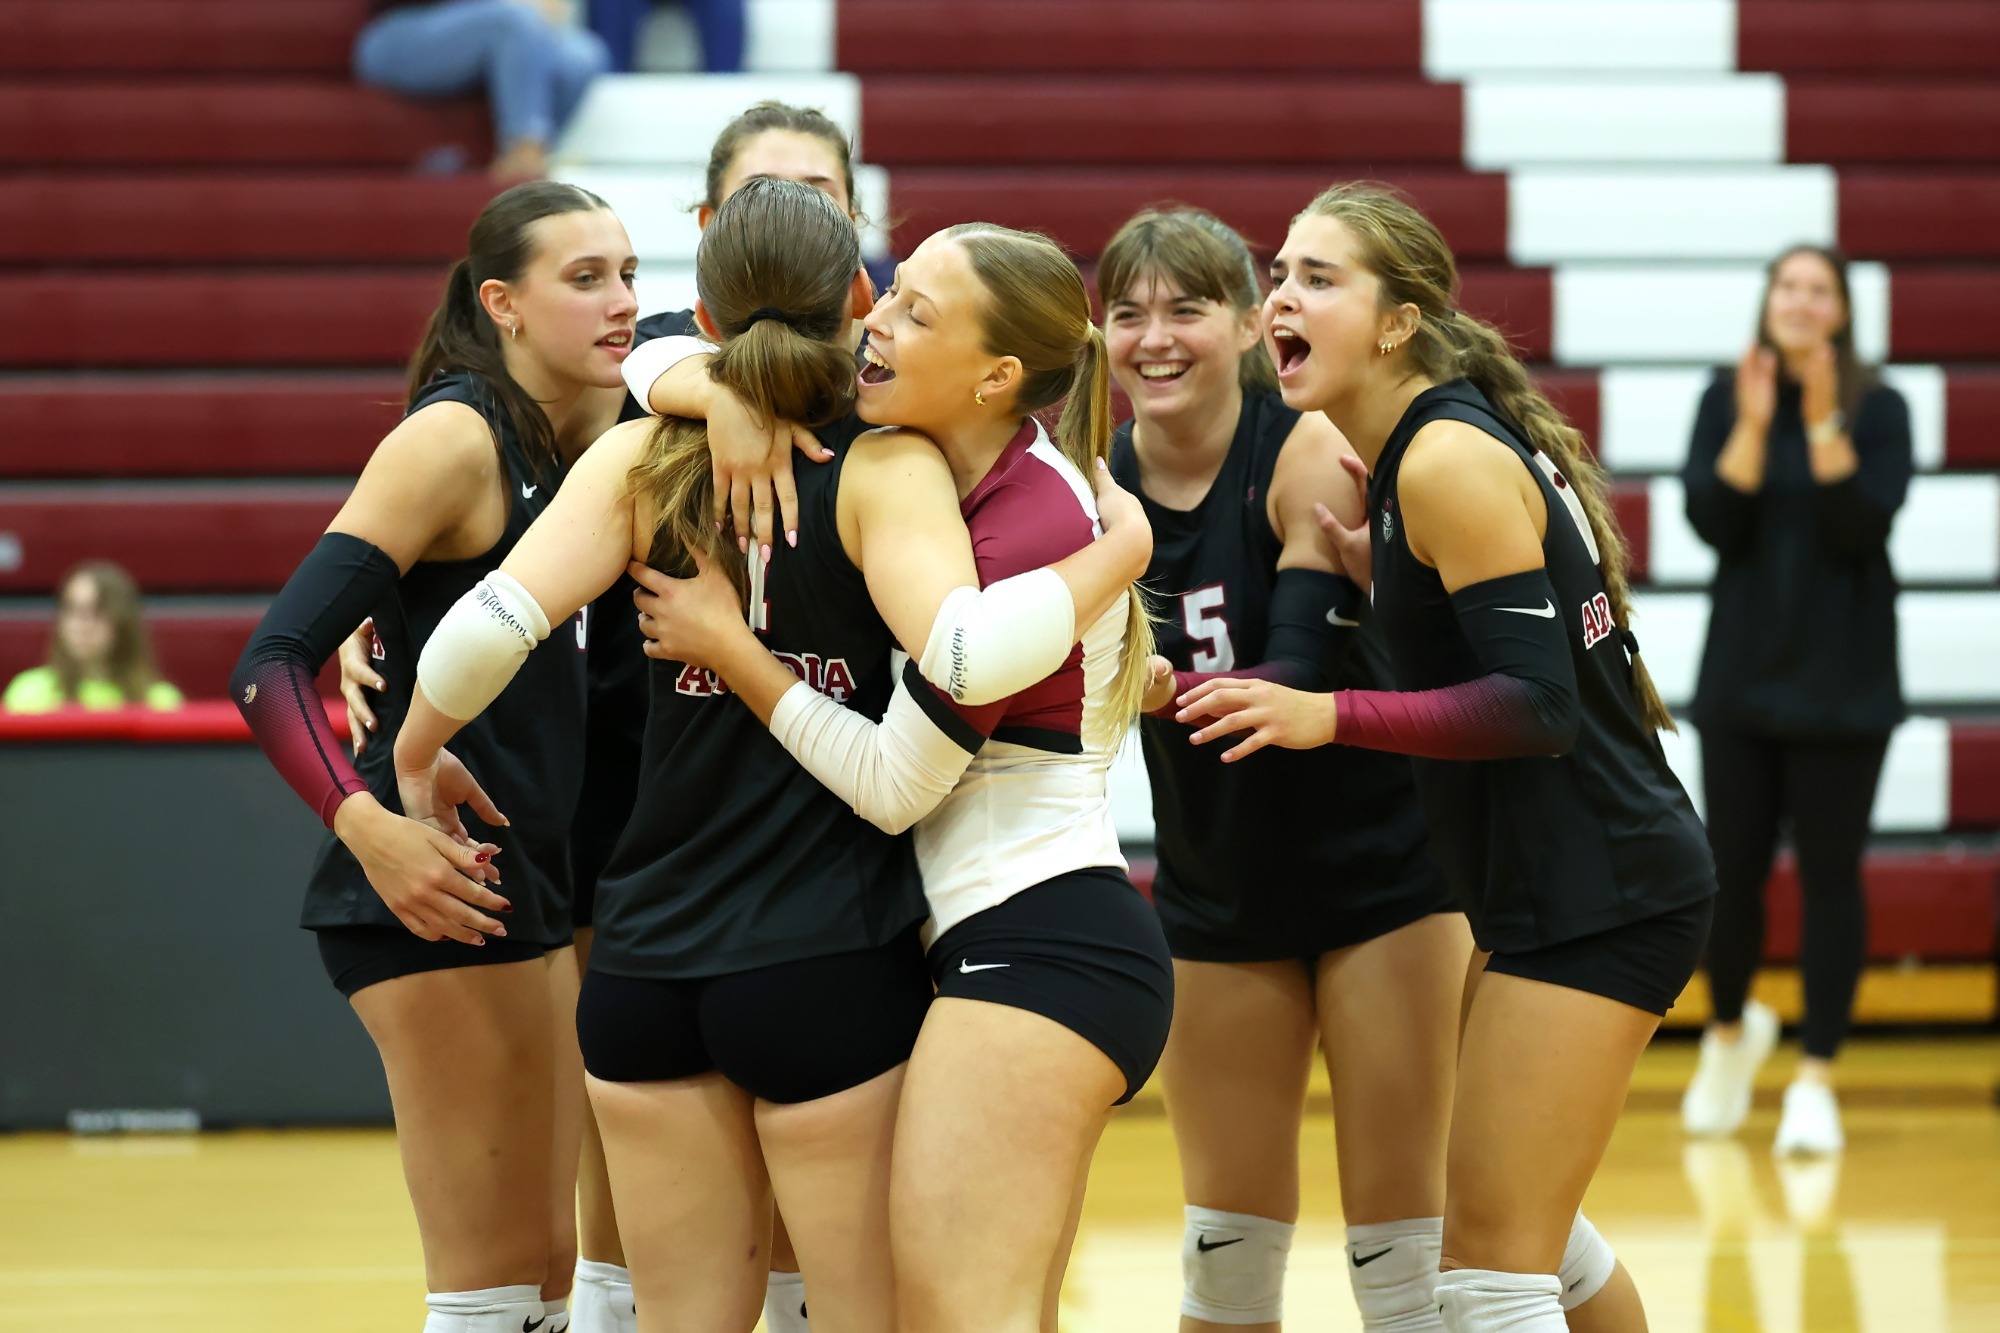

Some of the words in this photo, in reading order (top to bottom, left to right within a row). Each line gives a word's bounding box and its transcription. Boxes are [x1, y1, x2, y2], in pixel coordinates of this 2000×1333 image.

[480, 583, 527, 637] Tandem
[1181, 583, 1235, 674] 5
[1582, 592, 1616, 650] AR
[948, 627, 968, 691] Tandem
